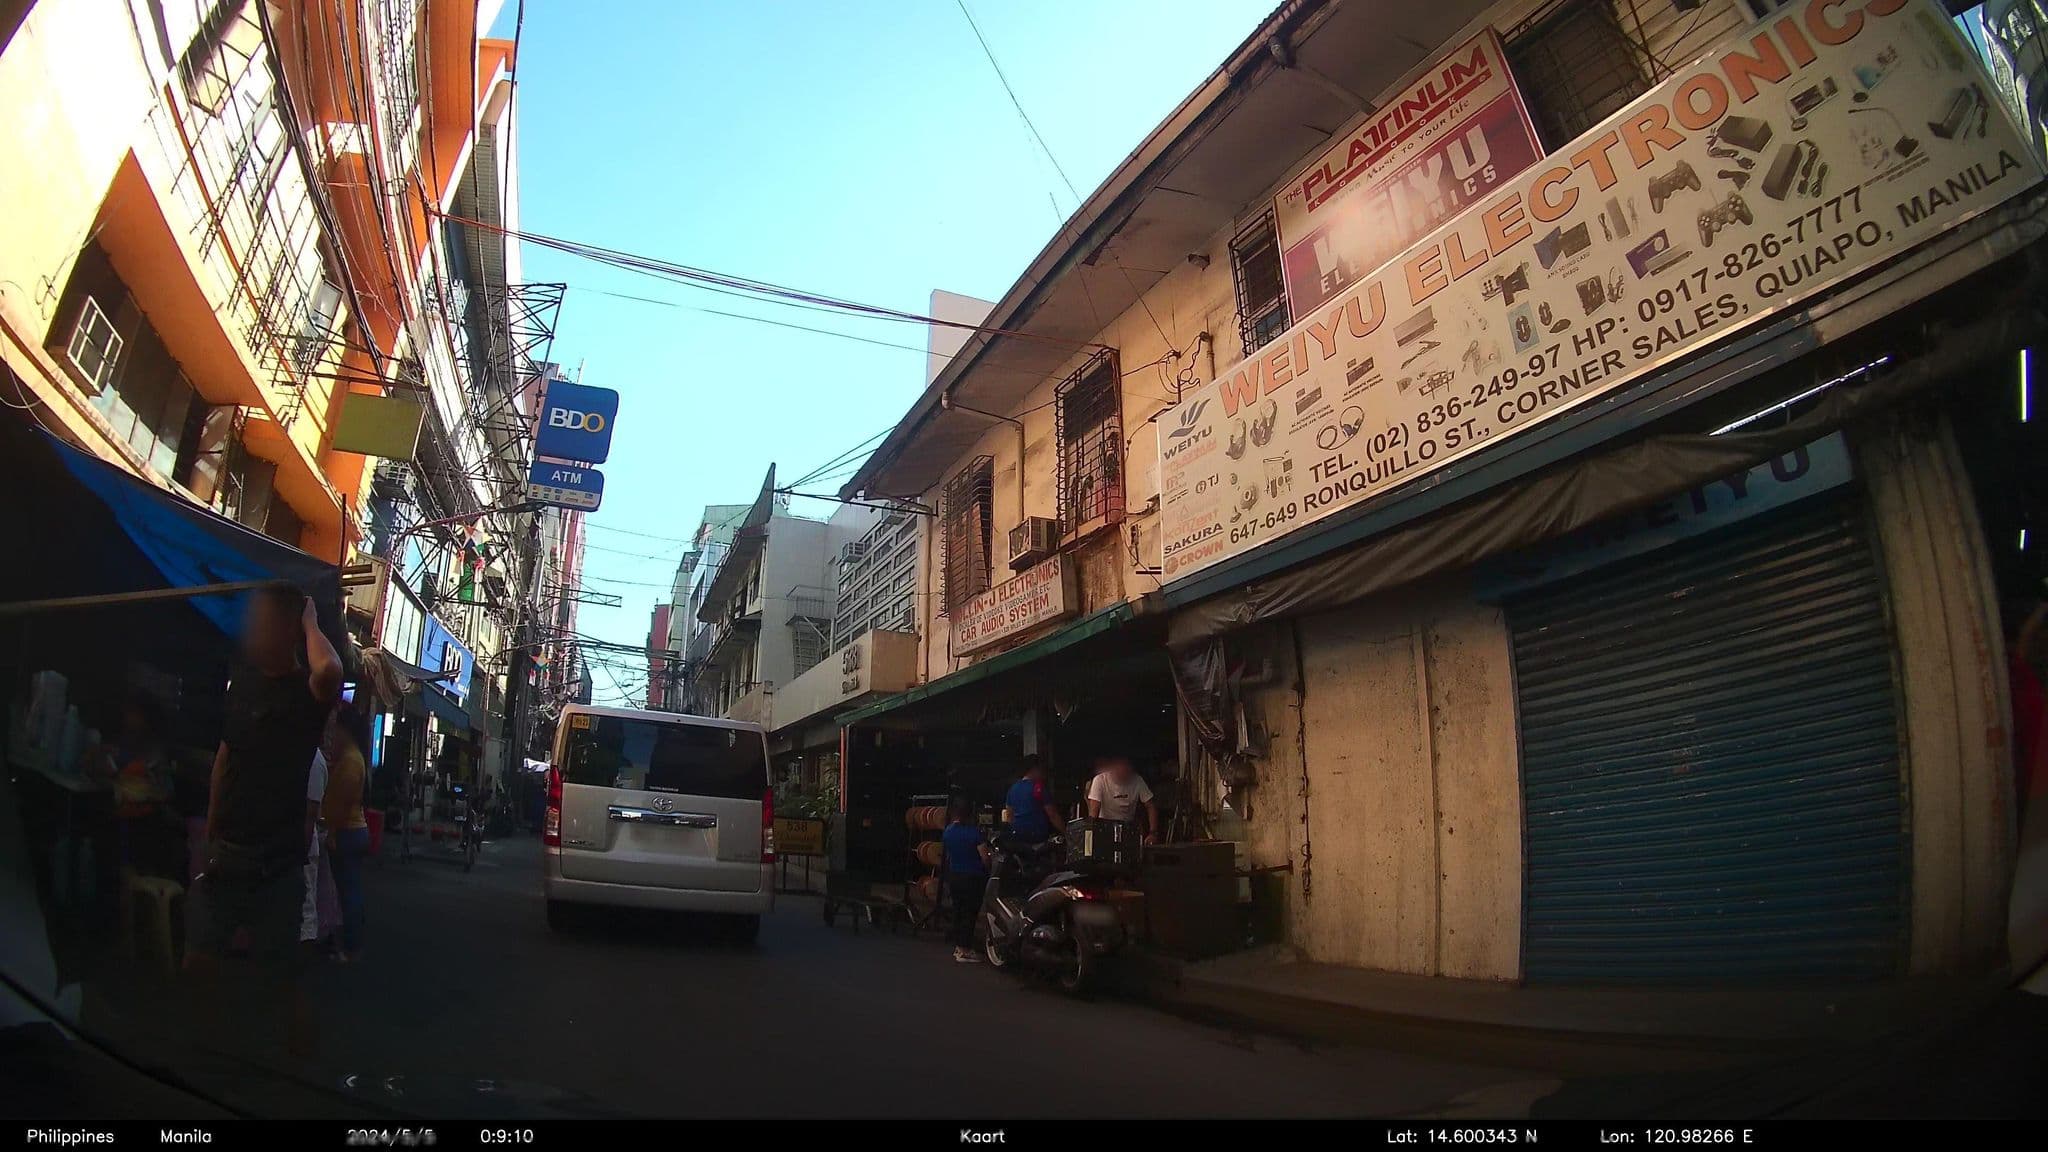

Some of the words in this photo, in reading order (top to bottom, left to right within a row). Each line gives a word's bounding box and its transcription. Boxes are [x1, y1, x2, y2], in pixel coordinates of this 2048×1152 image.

[1284, 186, 1304, 205] THE
[1302, 44, 1489, 203] PLATINUM
[1401, 142, 1415, 154] TO
[1418, 117, 1447, 140] YOUR
[1449, 99, 1471, 120] Life
[1218, 280, 1387, 419] WEIYU
[1230, 502, 1298, 544] 647-649
[1302, 439, 1438, 512] RONQUILLO
[1445, 420, 1490, 451] ST.,
[1496, 354, 1627, 424] CORNER
[1630, 292, 1750, 361] SALES,
[1754, 219, 1895, 299] QUIAPO,
[1894, 149, 2023, 228] MANILA
[1309, 449, 1359, 483] TEL.
[1365, 421, 1410, 463] (02)
[1417, 343, 1561, 434] 836-249-97
[1572, 316, 1629, 356] HP:
[1637, 184, 1865, 323] 0917-826-7777
[548, 407, 605, 433] BDO
[1163, 425, 1213, 461] WEIYU
[551, 470, 582, 484] ATM
[1208, 473, 1219, 487] TJ
[1164, 522, 1224, 555] SAKURA
[1179, 540, 1224, 566] CROWN
[999, 559, 1060, 602] ELECTRONICS
[961, 626, 976, 643] CAR
[981, 613, 1004, 636] AUDIO
[1009, 592, 1049, 623] SYSTEM
